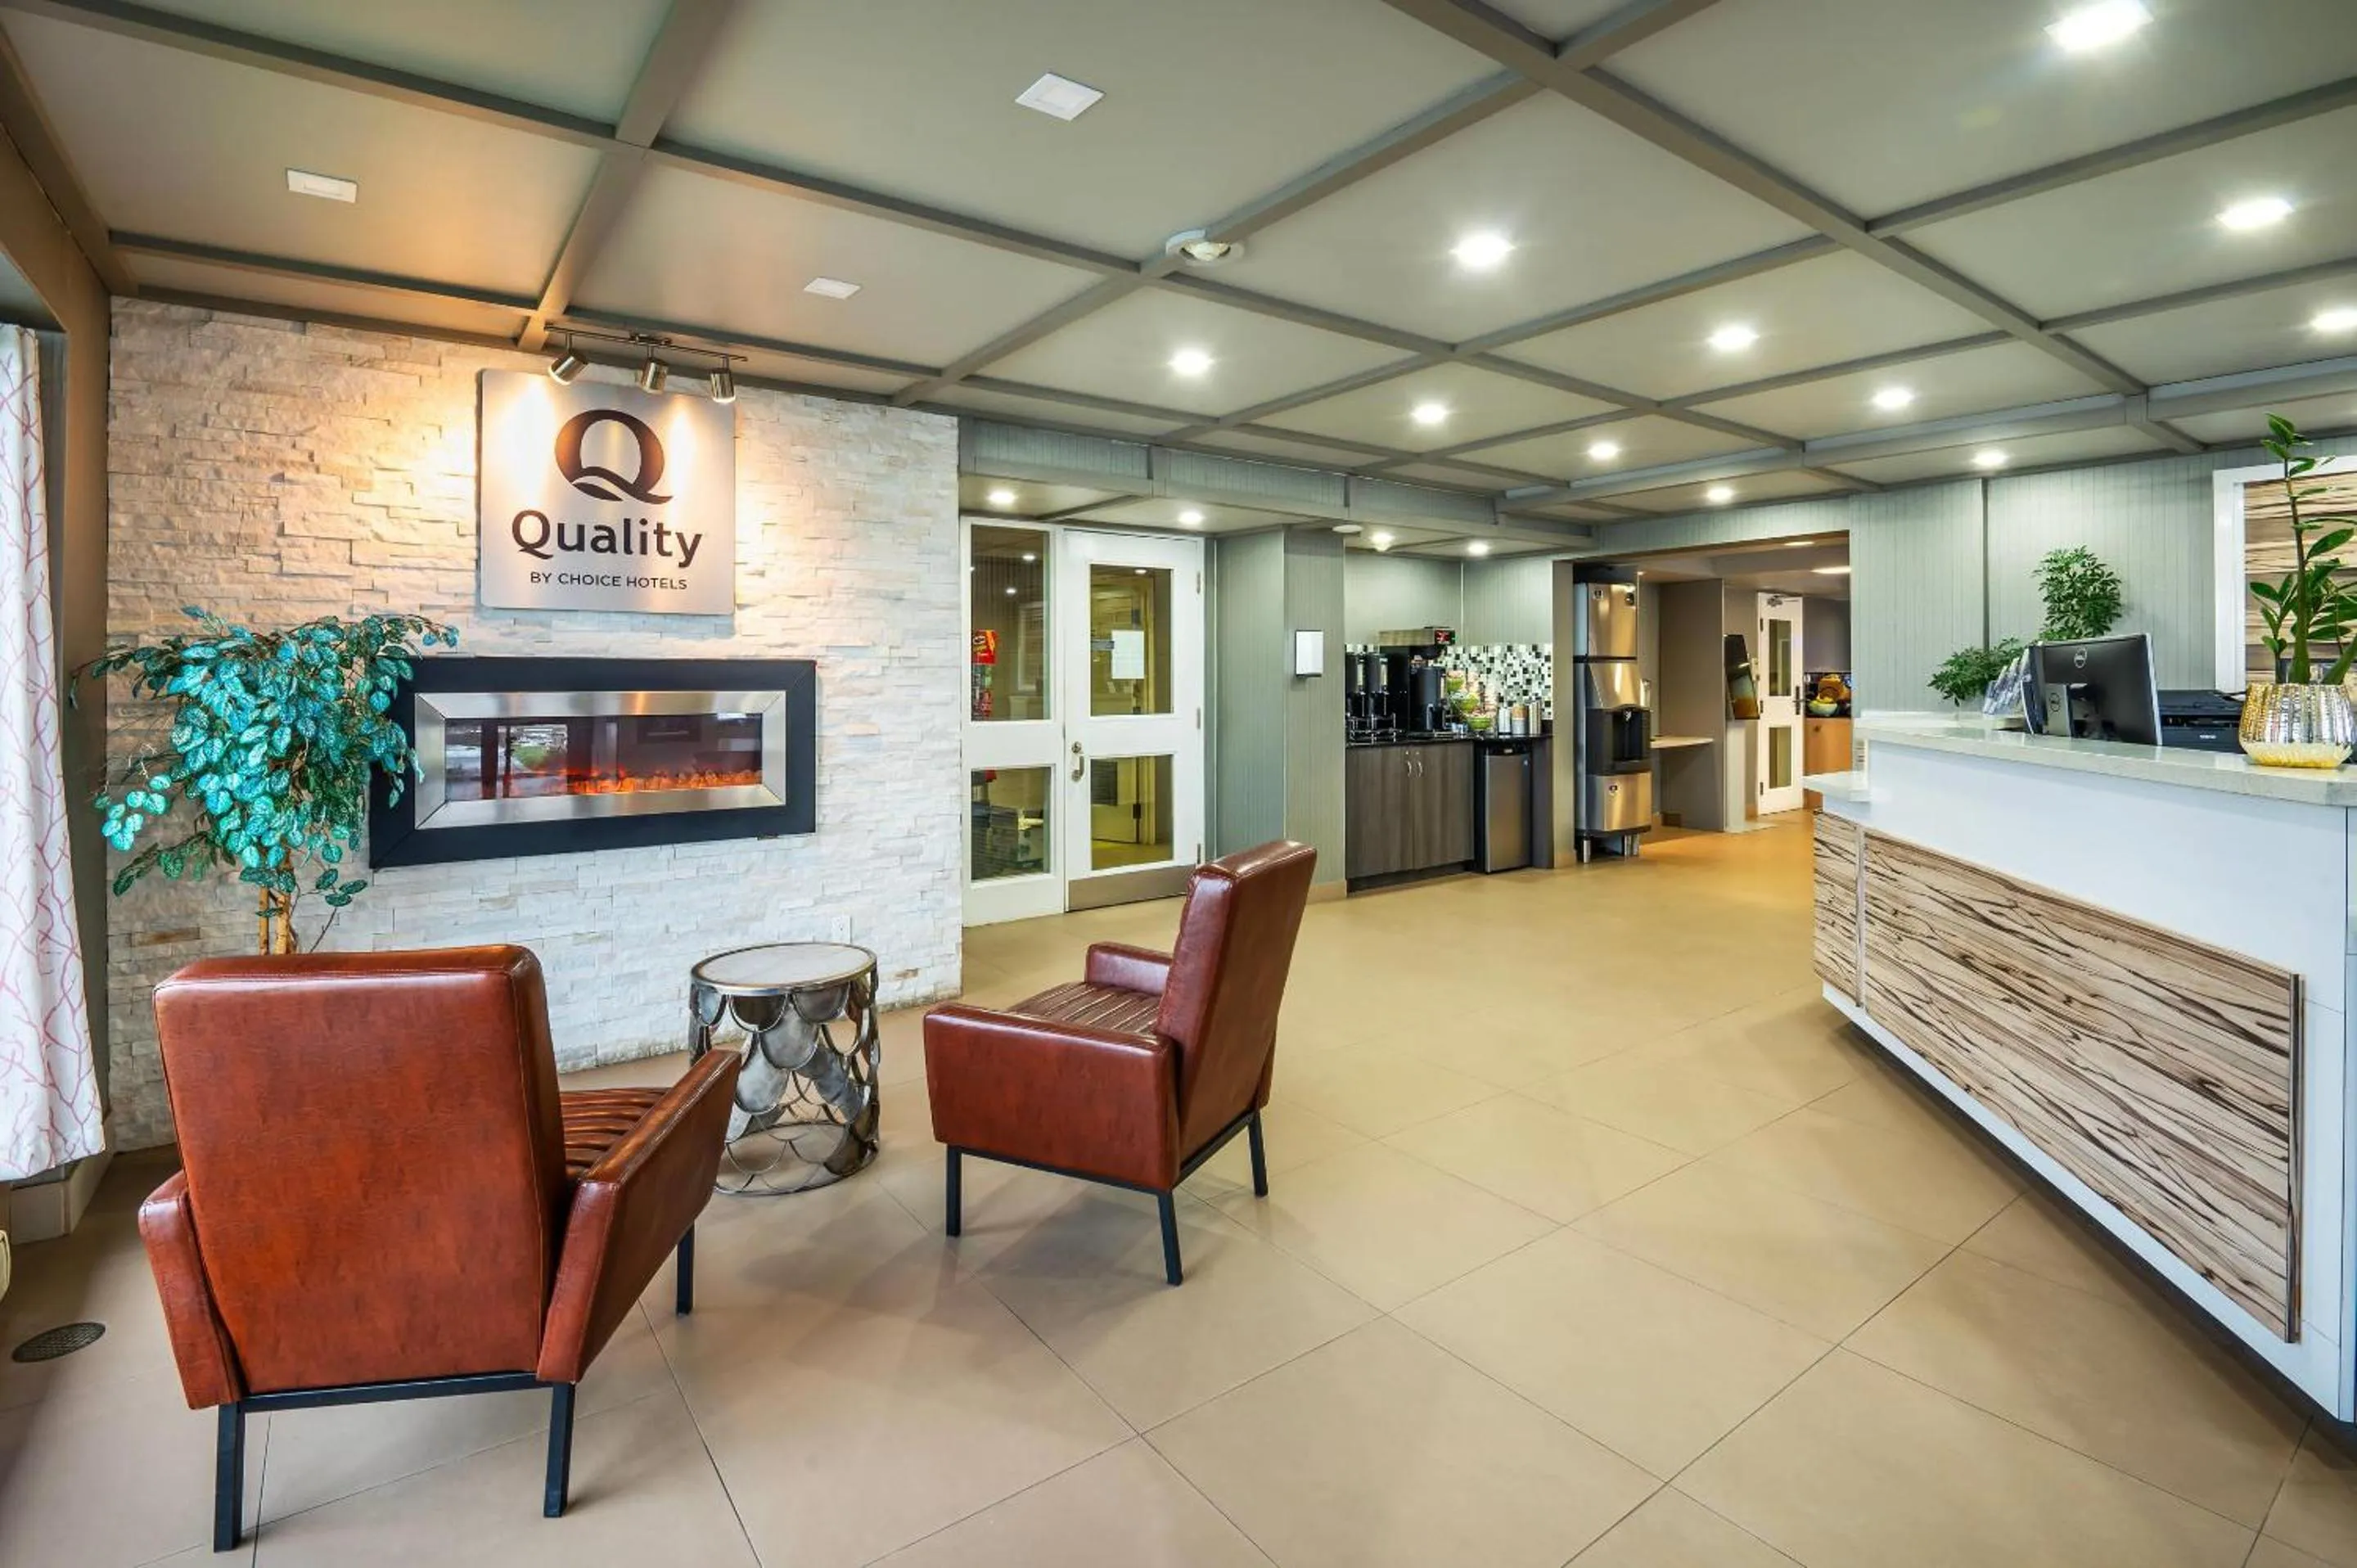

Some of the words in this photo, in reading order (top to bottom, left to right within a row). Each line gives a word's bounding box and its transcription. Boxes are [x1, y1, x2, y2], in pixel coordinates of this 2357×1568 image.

[554, 409, 673, 504] Q
[512, 510, 703, 568] Quality
[530, 571, 552, 583] BY
[558, 572, 622, 587] CHOICE
[626, 576, 687, 590] HOTELS
